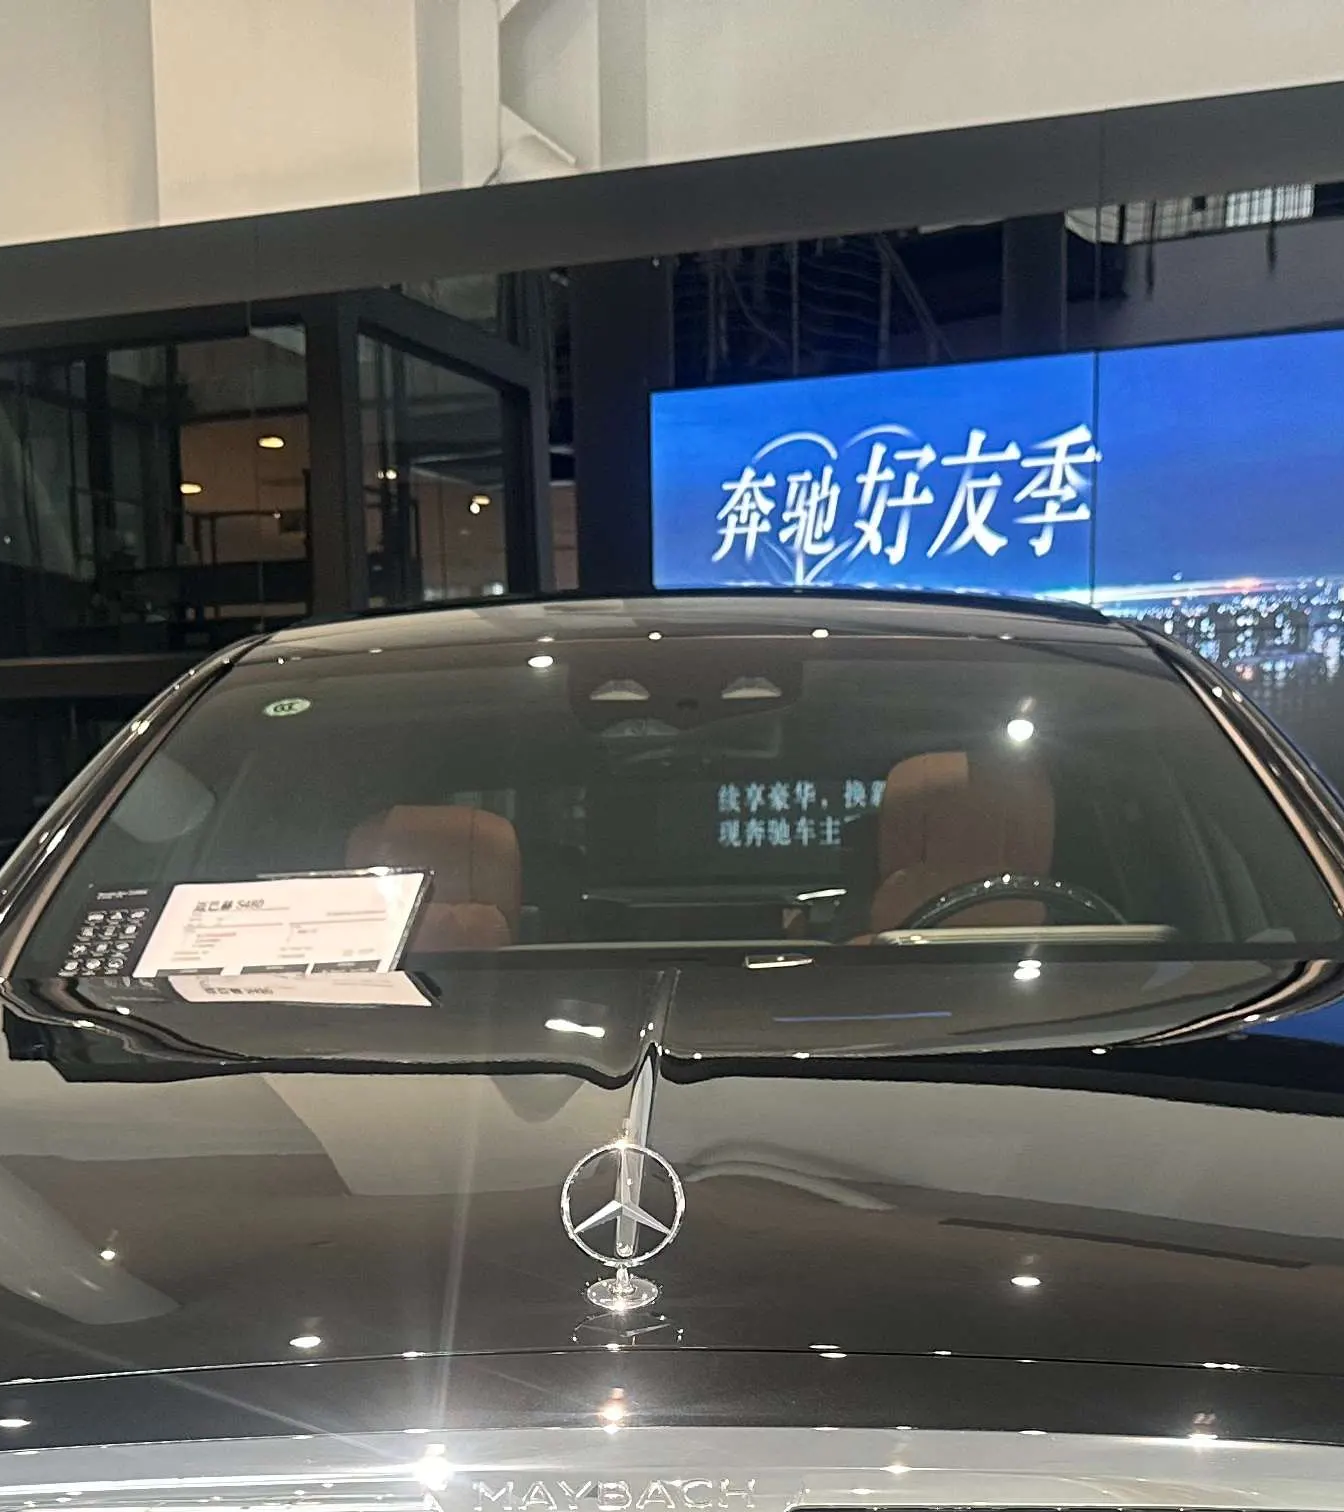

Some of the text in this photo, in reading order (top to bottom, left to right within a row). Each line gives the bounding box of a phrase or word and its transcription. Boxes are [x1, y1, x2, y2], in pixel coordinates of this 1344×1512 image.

[712, 424, 1102, 565] 奔驰好友季
[471, 1477, 757, 1512] MAYBACH
